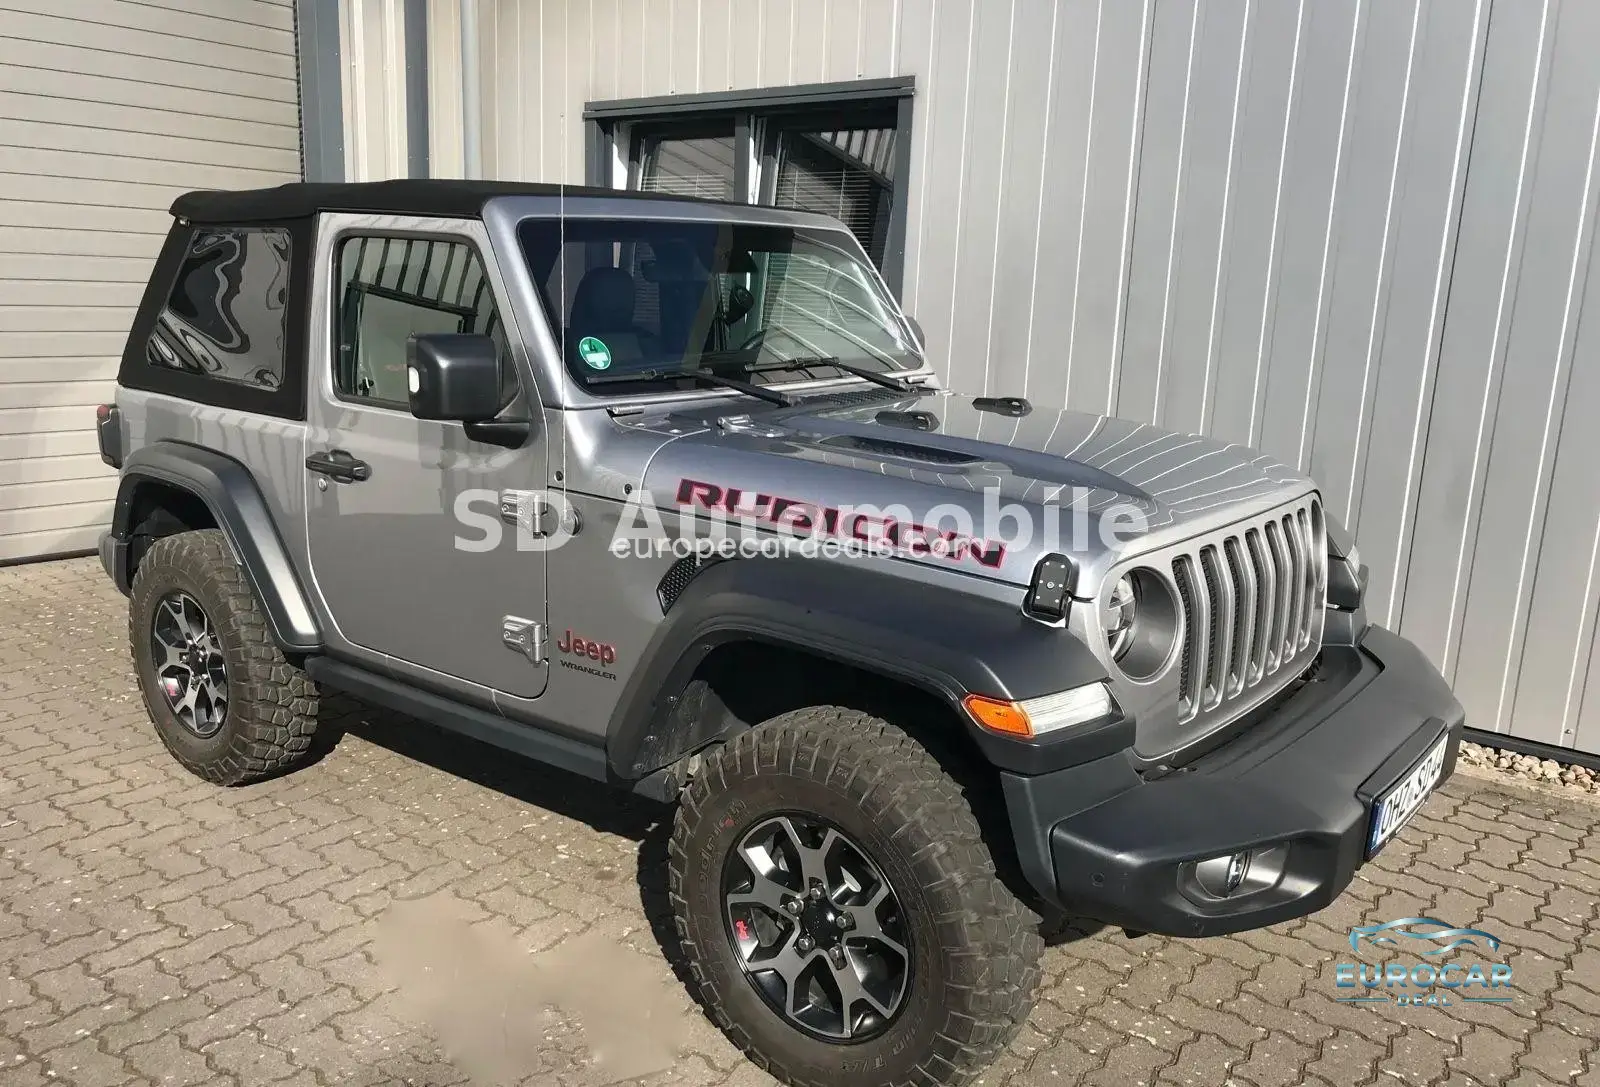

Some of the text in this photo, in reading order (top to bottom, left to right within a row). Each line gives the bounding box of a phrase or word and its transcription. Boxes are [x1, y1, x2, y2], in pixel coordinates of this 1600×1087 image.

[675, 478, 1008, 570] RUBICON
[557, 628, 617, 667] Jeep
[559, 659, 617, 681] WRANGLER
